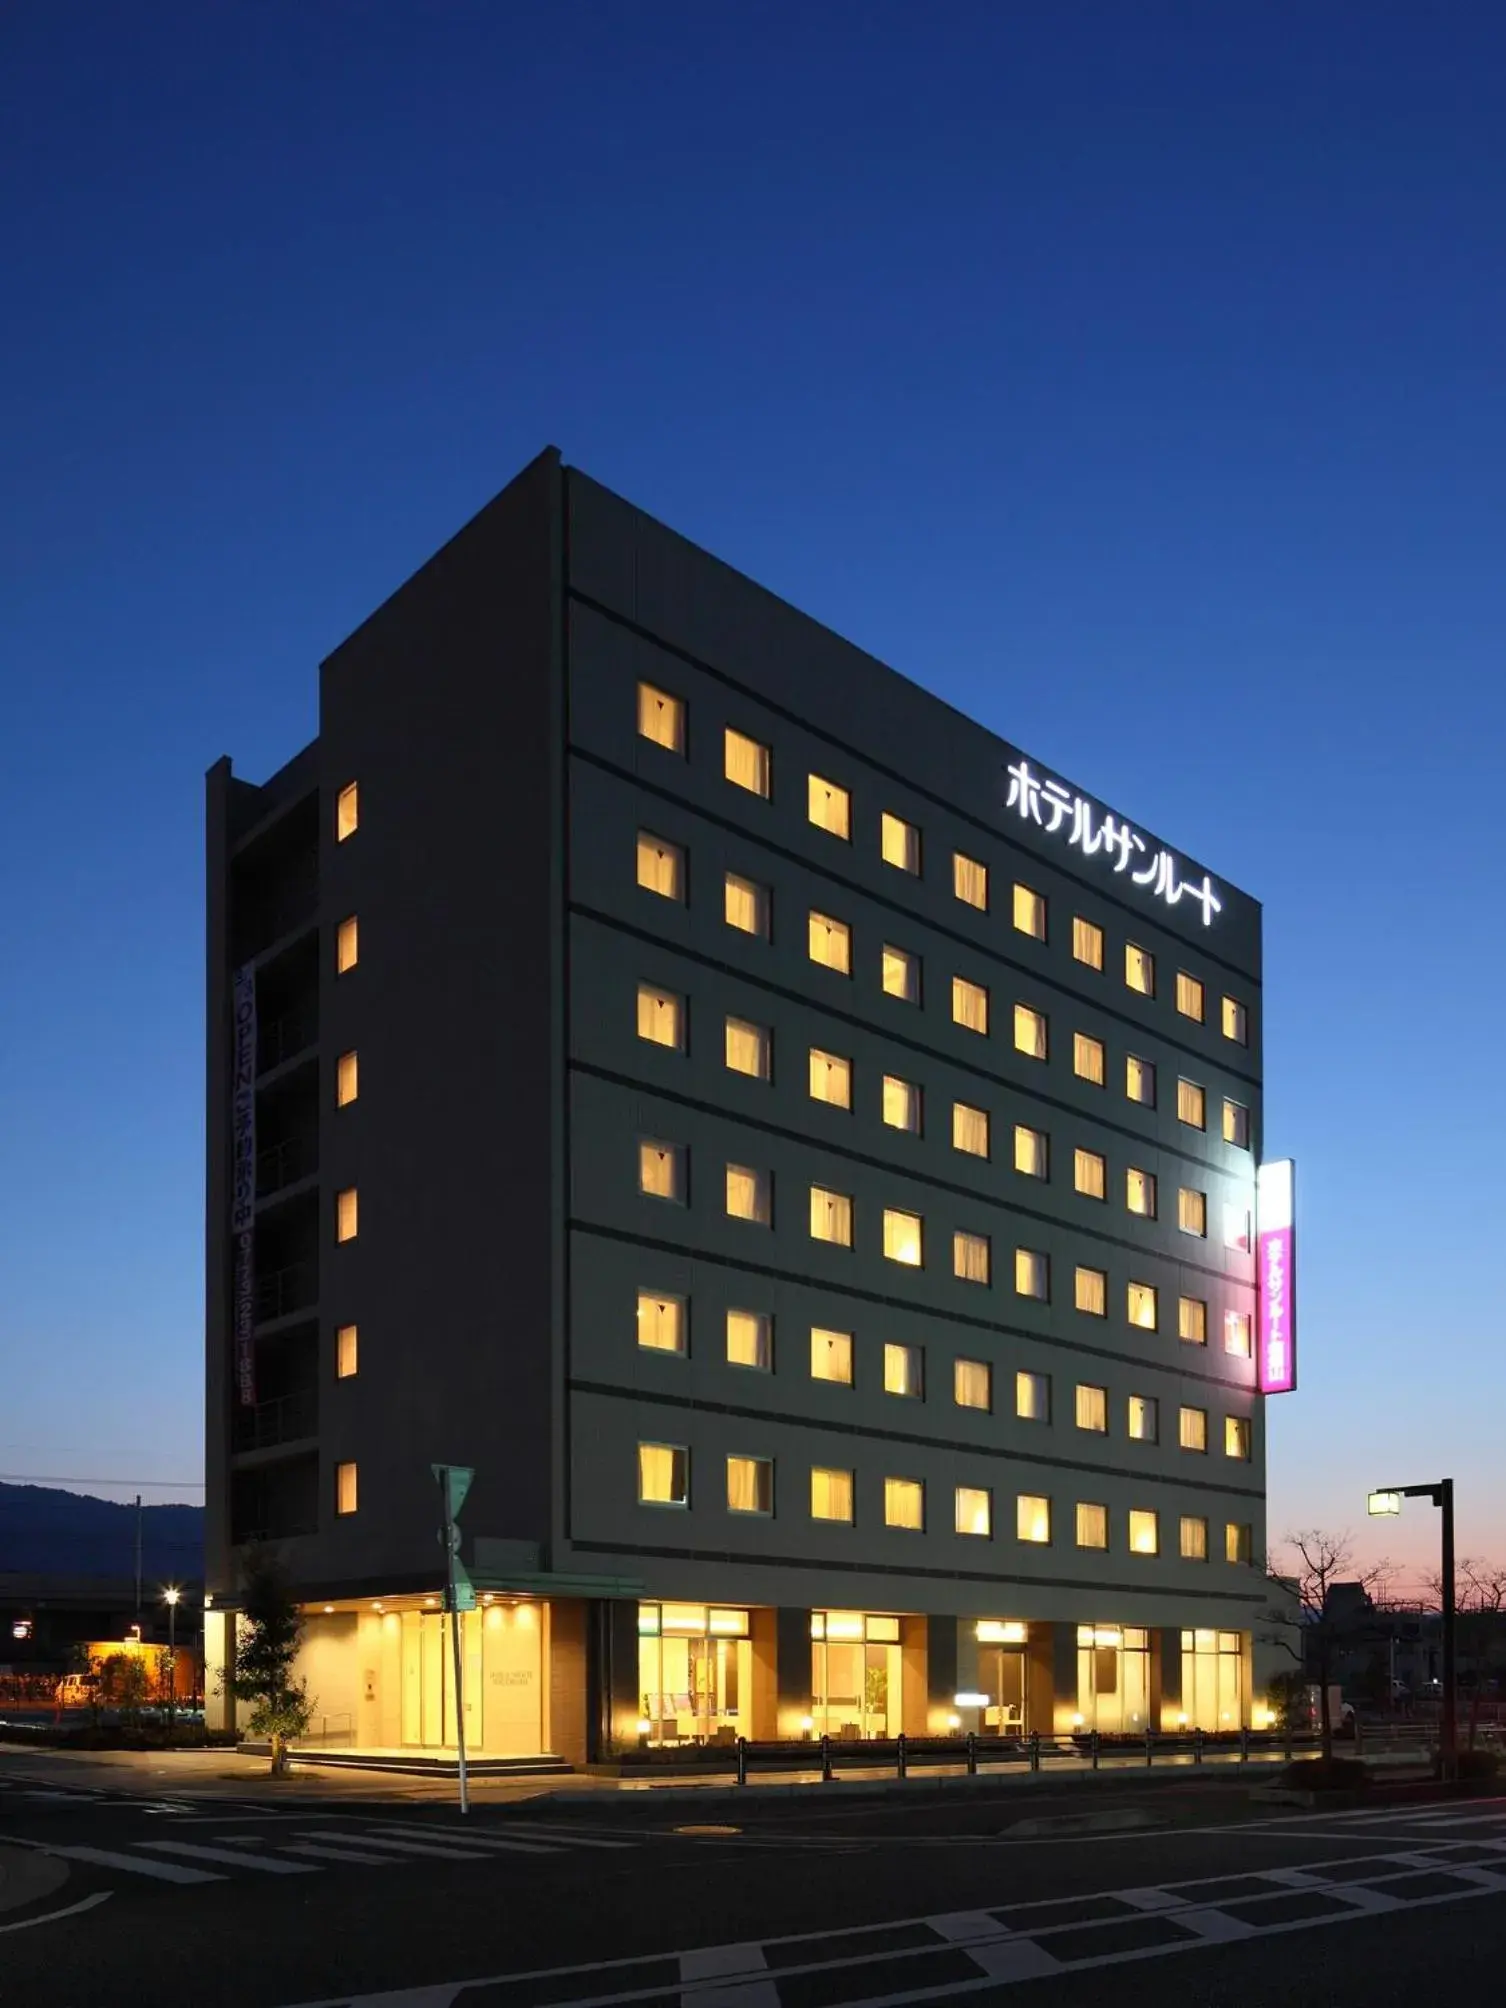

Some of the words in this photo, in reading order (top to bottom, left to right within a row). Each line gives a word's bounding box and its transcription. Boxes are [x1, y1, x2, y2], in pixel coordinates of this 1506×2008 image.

[1005, 760, 1222, 927] ホテルサンルート
